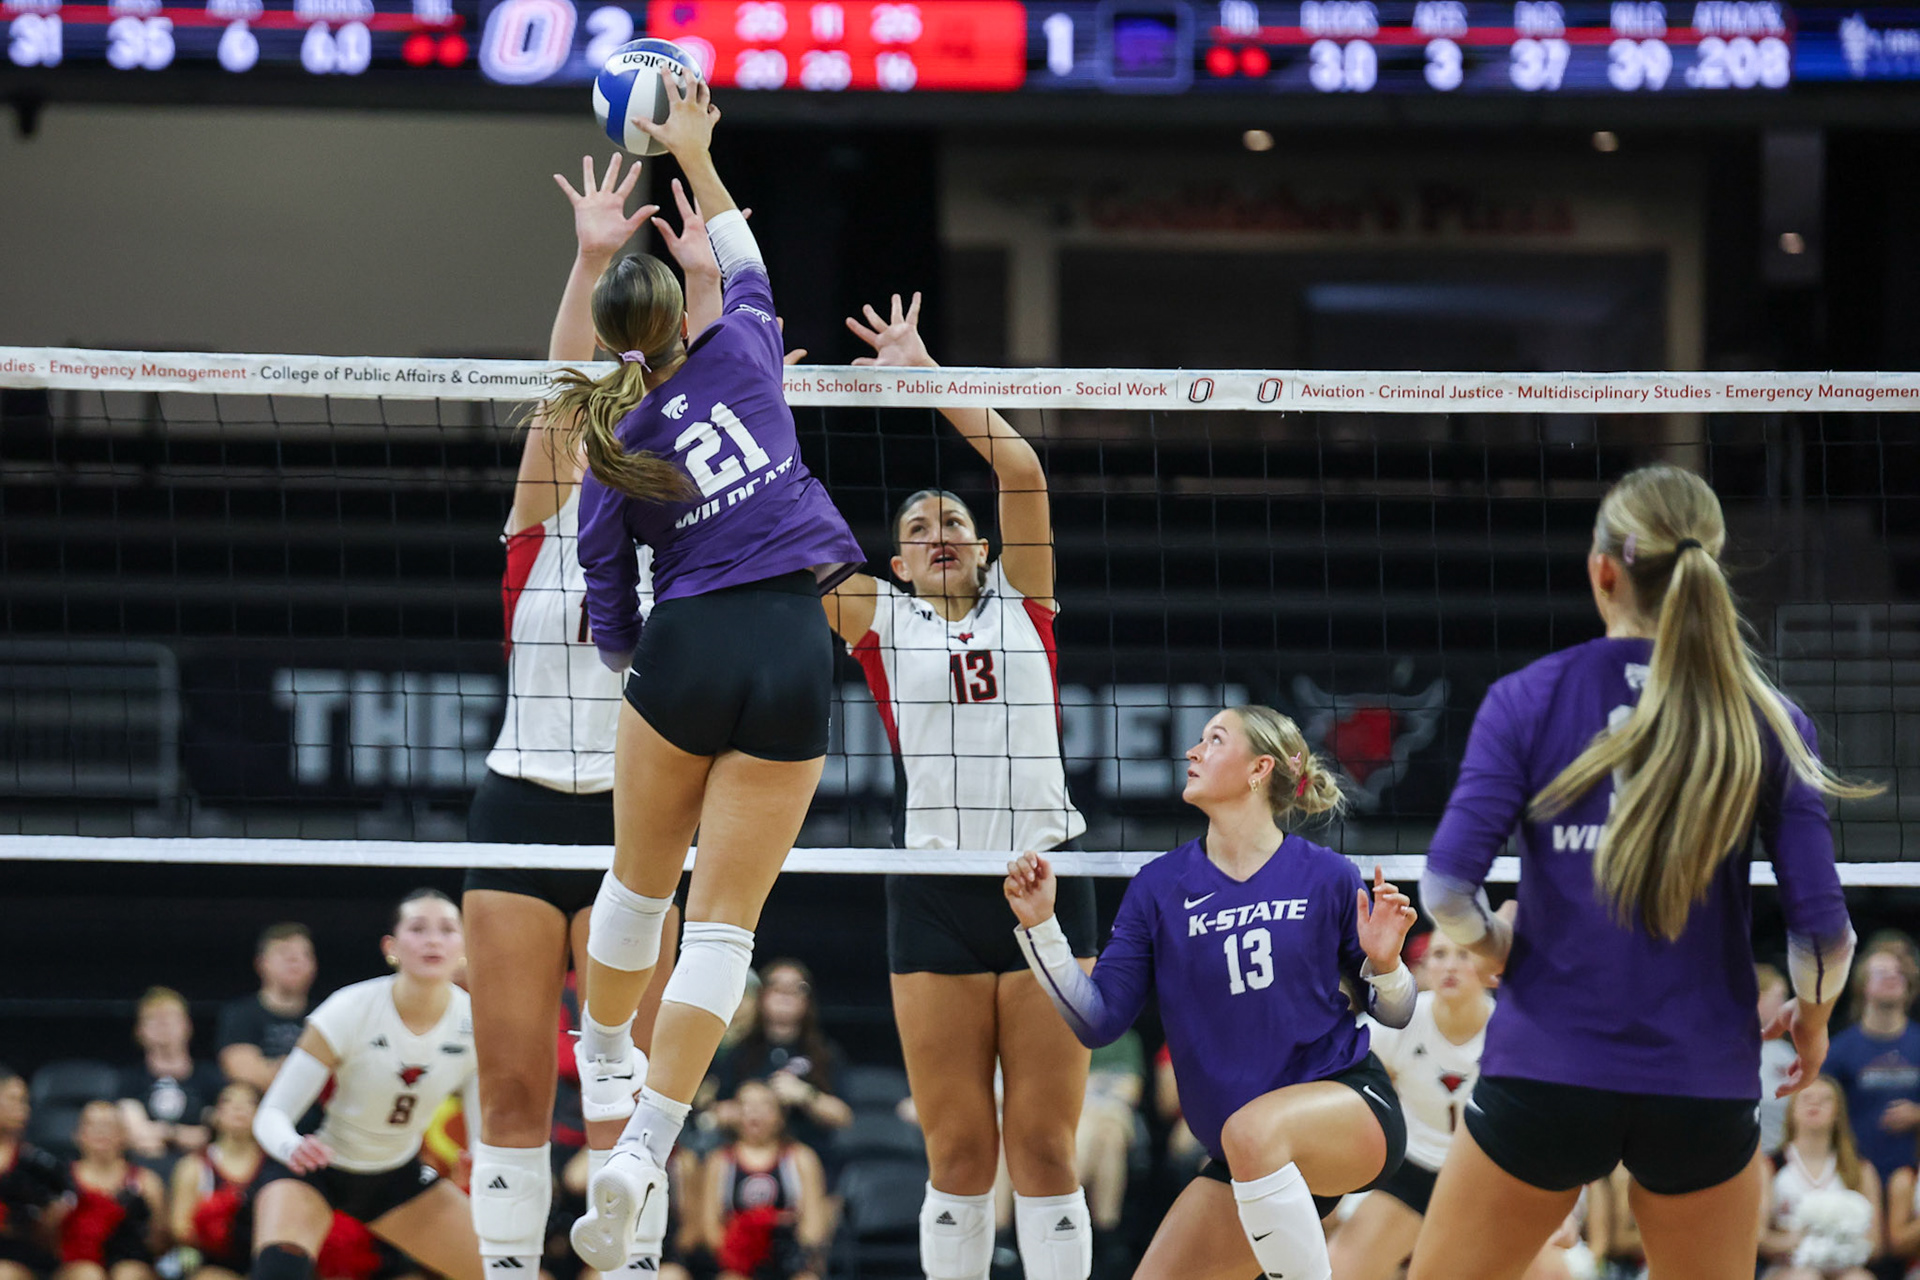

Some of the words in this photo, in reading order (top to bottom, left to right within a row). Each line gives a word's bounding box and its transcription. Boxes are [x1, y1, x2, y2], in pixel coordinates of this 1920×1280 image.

[623, 53, 683, 76] molten
[1043, 13, 1074, 77] 1
[1424, 39, 1464, 91] 3
[1509, 38, 1571, 91] 37
[1607, 38, 1673, 91] 39
[1685, 36, 1791, 89] .208
[50, 360, 136, 379] Emergency
[142, 364, 247, 382] Management
[260, 366, 319, 384] College
[324, 367, 340, 381] of
[344, 368, 391, 383] Public
[395, 369, 447, 384] Affairs
[451, 370, 462, 384] &
[816, 379, 883, 393] Scholars
[896, 380, 943, 395] Public
[947, 381, 1062, 396] Administration
[1075, 381, 1122, 396] Social
[1127, 383, 1167, 397] Work
[1301, 384, 1365, 399] Aviation
[1378, 384, 1445, 399] Criminal
[1449, 385, 1504, 399] Justice
[1517, 384, 1650, 403] Multidisciplinary
[1654, 384, 1712, 399] Studies
[1725, 385, 1814, 402] Emergency
[674, 402, 771, 498] 21
[950, 650, 998, 705] 13
[272, 668, 503, 786] THE
[1188, 898, 1308, 937] K-STATE
[1223, 927, 1275, 995] 13
[388, 1093, 418, 1126] 8
